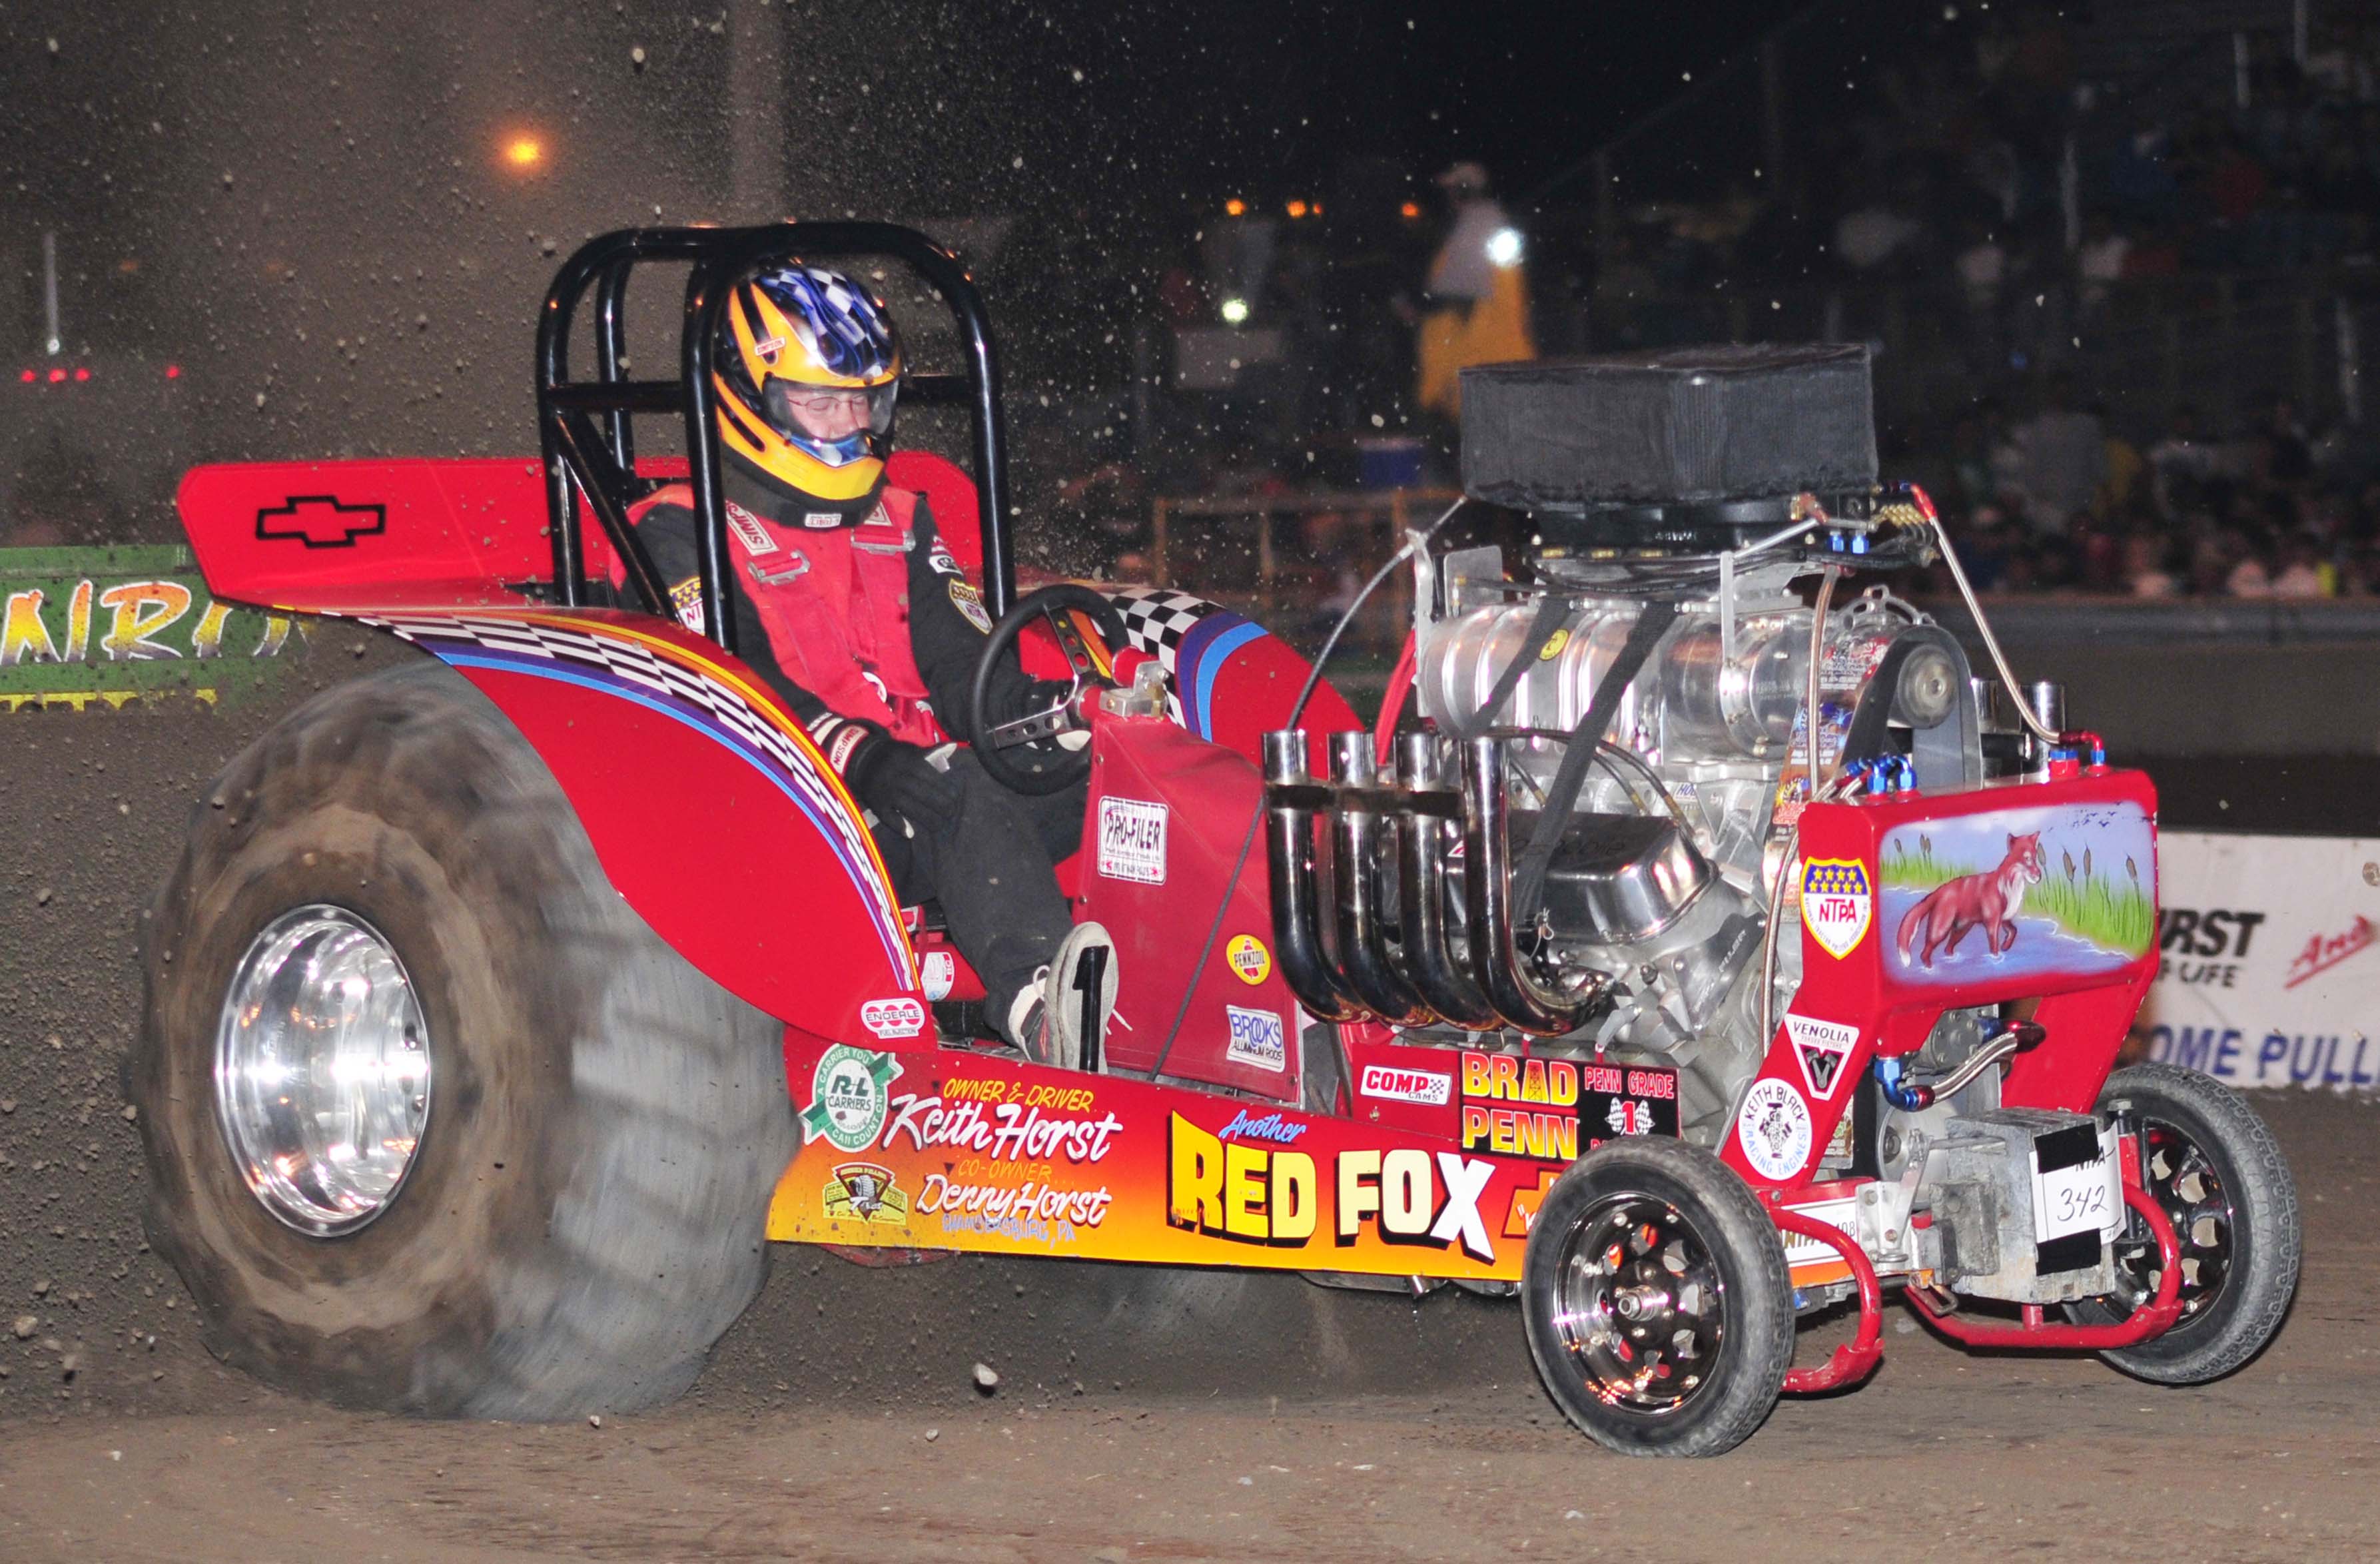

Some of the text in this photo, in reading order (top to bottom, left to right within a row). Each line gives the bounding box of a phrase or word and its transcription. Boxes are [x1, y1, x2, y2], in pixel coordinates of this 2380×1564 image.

[1106, 815, 1160, 852] PRO-FILER
[1819, 899, 1857, 923] NTPA
[1234, 950, 1265, 967] PENNZOIL
[866, 1009, 920, 1022] ENDERLE
[1230, 1013, 1282, 1048] BROOKS
[1794, 1021, 1849, 1044] VENOLIA
[819, 1048, 850, 1082] CARRIER
[852, 1049, 870, 1064] YOU
[1265, 1048, 1282, 1061] RODS
[2257, 1033, 2380, 1084] PULL
[943, 1078, 1006, 1103] OWNER
[1006, 1081, 1024, 1103] &
[1366, 1070, 1429, 1094] COMP
[1462, 1051, 1578, 1106] BRAD
[1585, 1066, 1675, 1099] PENN GRADE
[827, 1096, 872, 1112] CARRIERS
[1408, 1091, 1439, 1102] CAMS
[1745, 1085, 1806, 1123] KEITH BLACK
[853, 1118, 880, 1145] COUNT
[882, 1094, 1123, 1162] Keith Horst
[1220, 1108, 1306, 1143] Another
[1462, 1105, 1578, 1160] PENN
[1621, 1100, 1635, 1135] 1
[1745, 1130, 1773, 1174] RACING
[1778, 1133, 1807, 1175] ENGINES
[916, 1174, 1112, 1226] Denny Horst
[1170, 1109, 1496, 1263] RED FOX
[2057, 1184, 2108, 1222] 342
[1056, 1219, 1077, 1242] PA
[1836, 1221, 1856, 1237] 08
